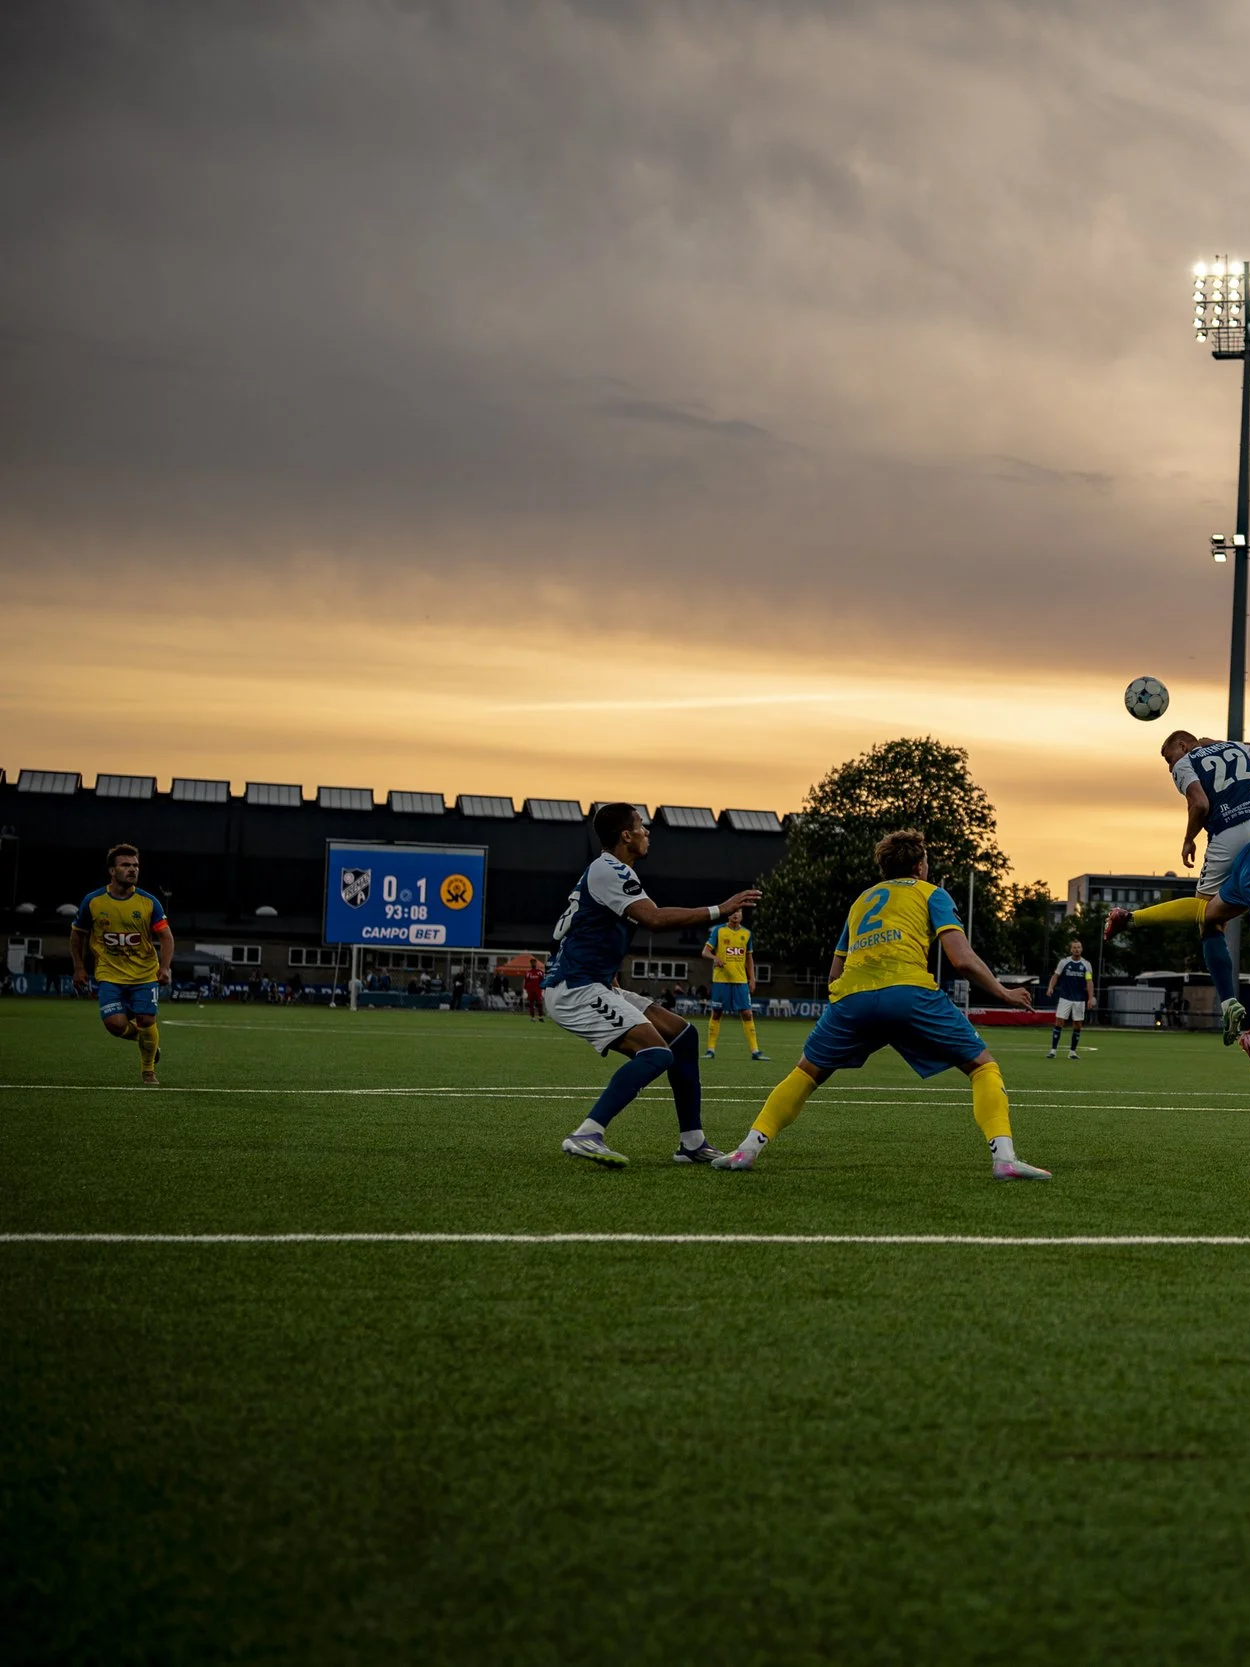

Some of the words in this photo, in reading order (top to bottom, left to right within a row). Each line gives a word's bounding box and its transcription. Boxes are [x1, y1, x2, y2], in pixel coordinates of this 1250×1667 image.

[1220, 803, 1230, 813] JR
[382, 875, 398, 903] 0
[416, 877, 427, 903] 1
[384, 904, 427, 920] 93:08
[857, 888, 890, 936] 2
[103, 932, 141, 946] SIC
[362, 926, 408, 940] CAMPO
[415, 929, 440, 940] BET
[726, 947, 744, 956] SIC
